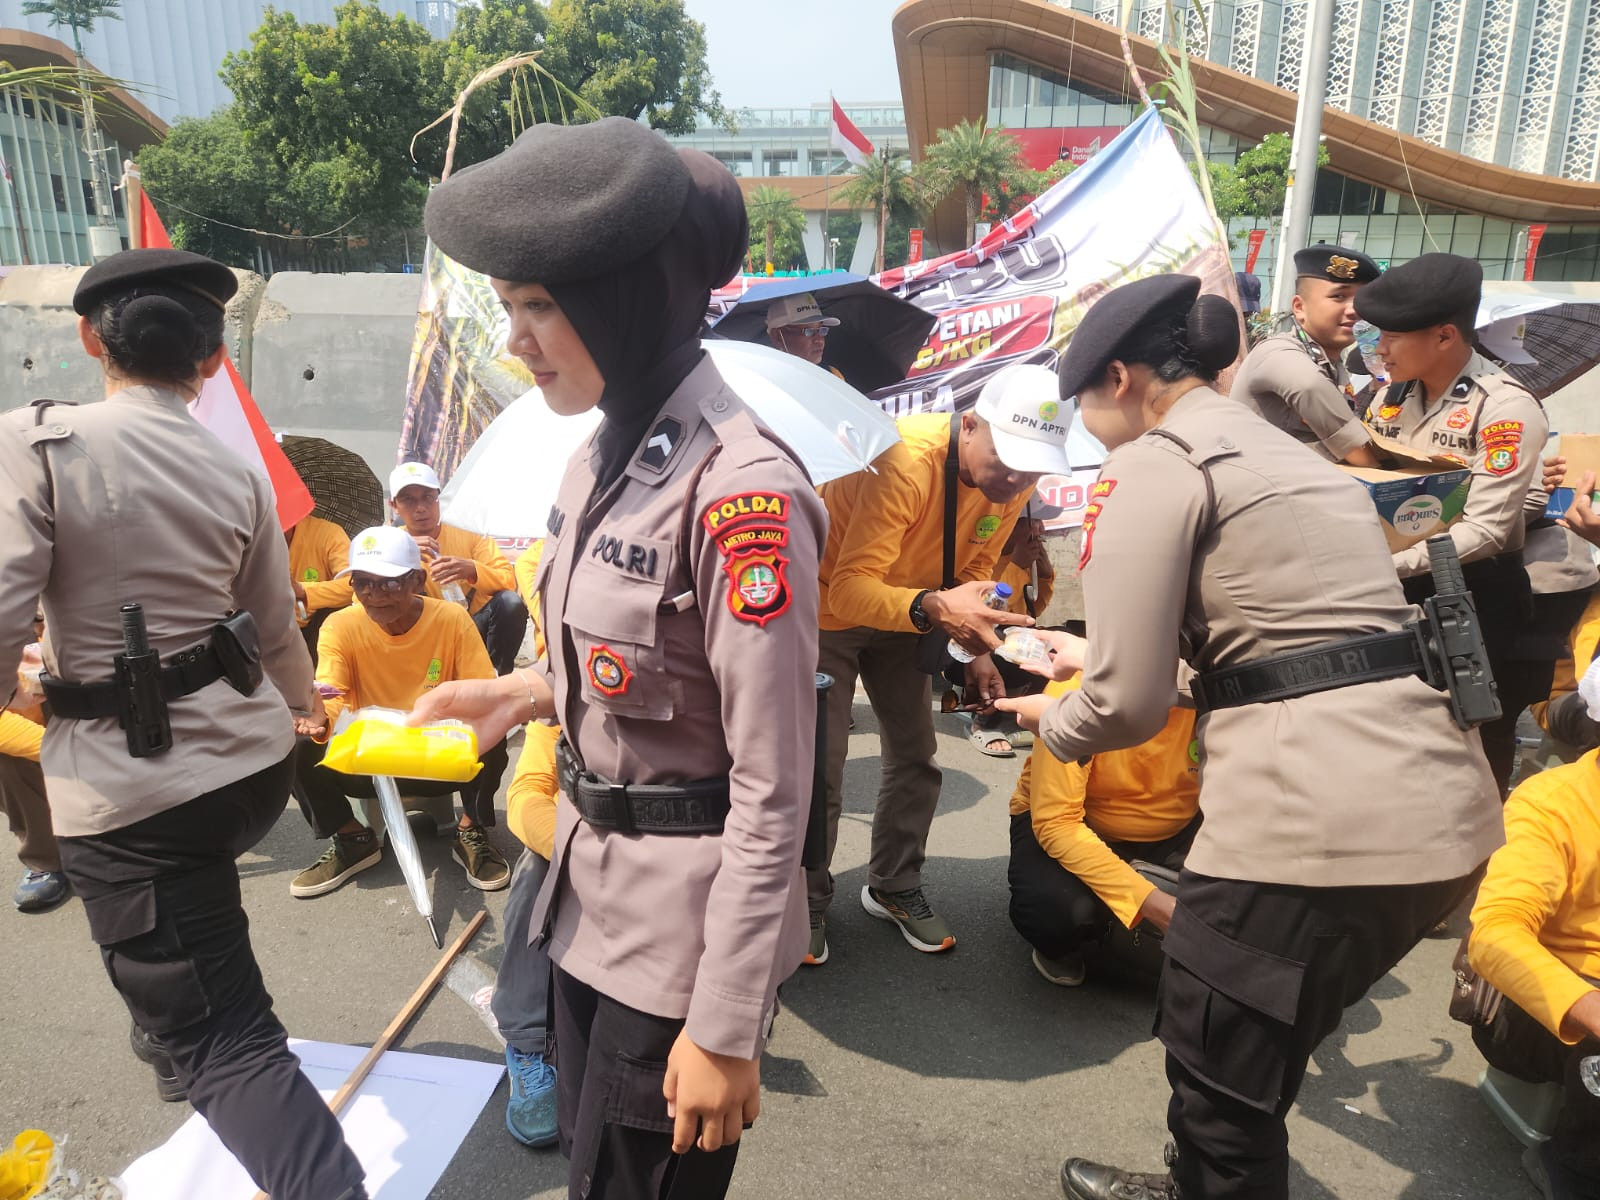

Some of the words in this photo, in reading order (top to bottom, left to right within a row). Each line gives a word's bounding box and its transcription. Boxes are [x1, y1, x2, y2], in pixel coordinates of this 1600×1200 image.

[1012, 413, 1038, 429] DPN
[1484, 422, 1520, 436] POLDA
[709, 496, 781, 529] POLDA
[1396, 508, 1440, 524] SanQua
[723, 532, 756, 549] METRO
[758, 531, 782, 542] JAYA
[592, 534, 658, 578] POLRI
